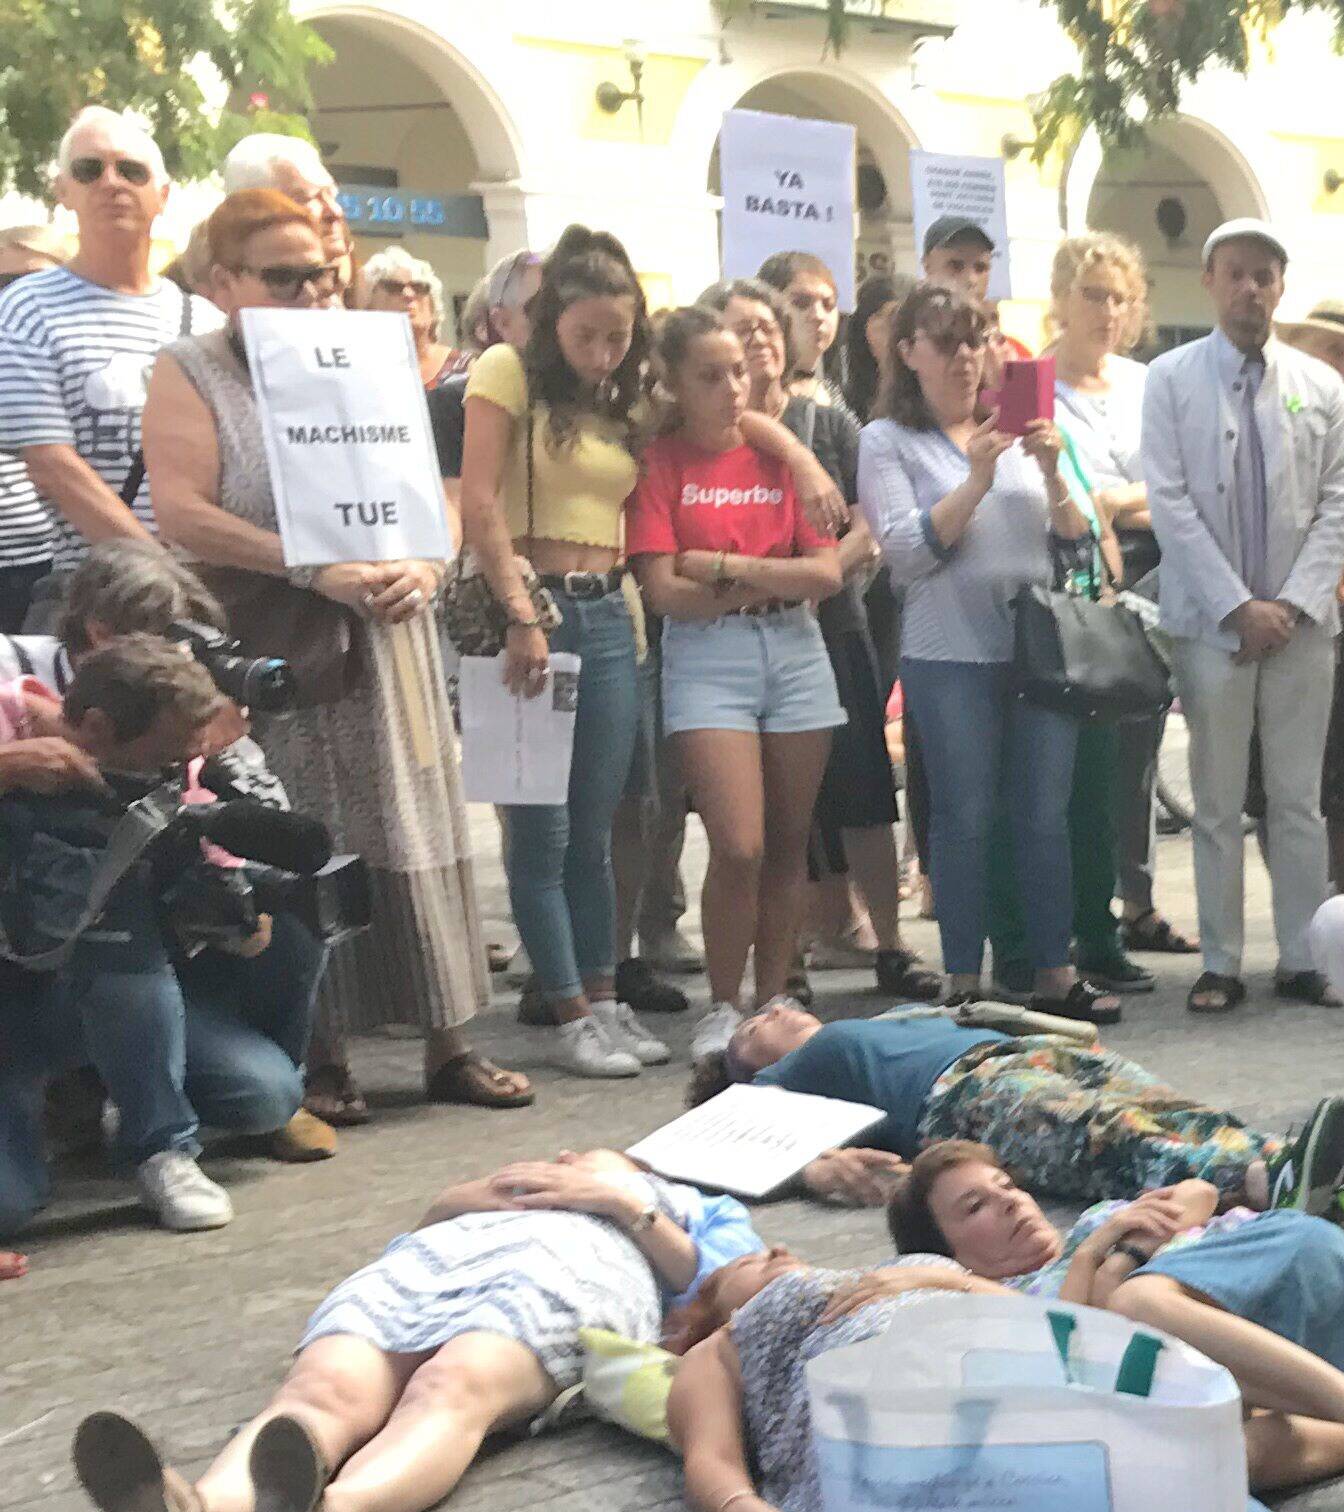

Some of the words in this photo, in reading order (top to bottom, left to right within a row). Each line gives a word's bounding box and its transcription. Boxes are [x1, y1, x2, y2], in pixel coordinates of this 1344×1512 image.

[774, 169, 804, 189] YA
[744, 194, 820, 221] BASTA
[314, 347, 350, 368] LE
[287, 425, 412, 444] MACHISME
[682, 483, 783, 508] Superbe
[334, 500, 399, 527] TUE
